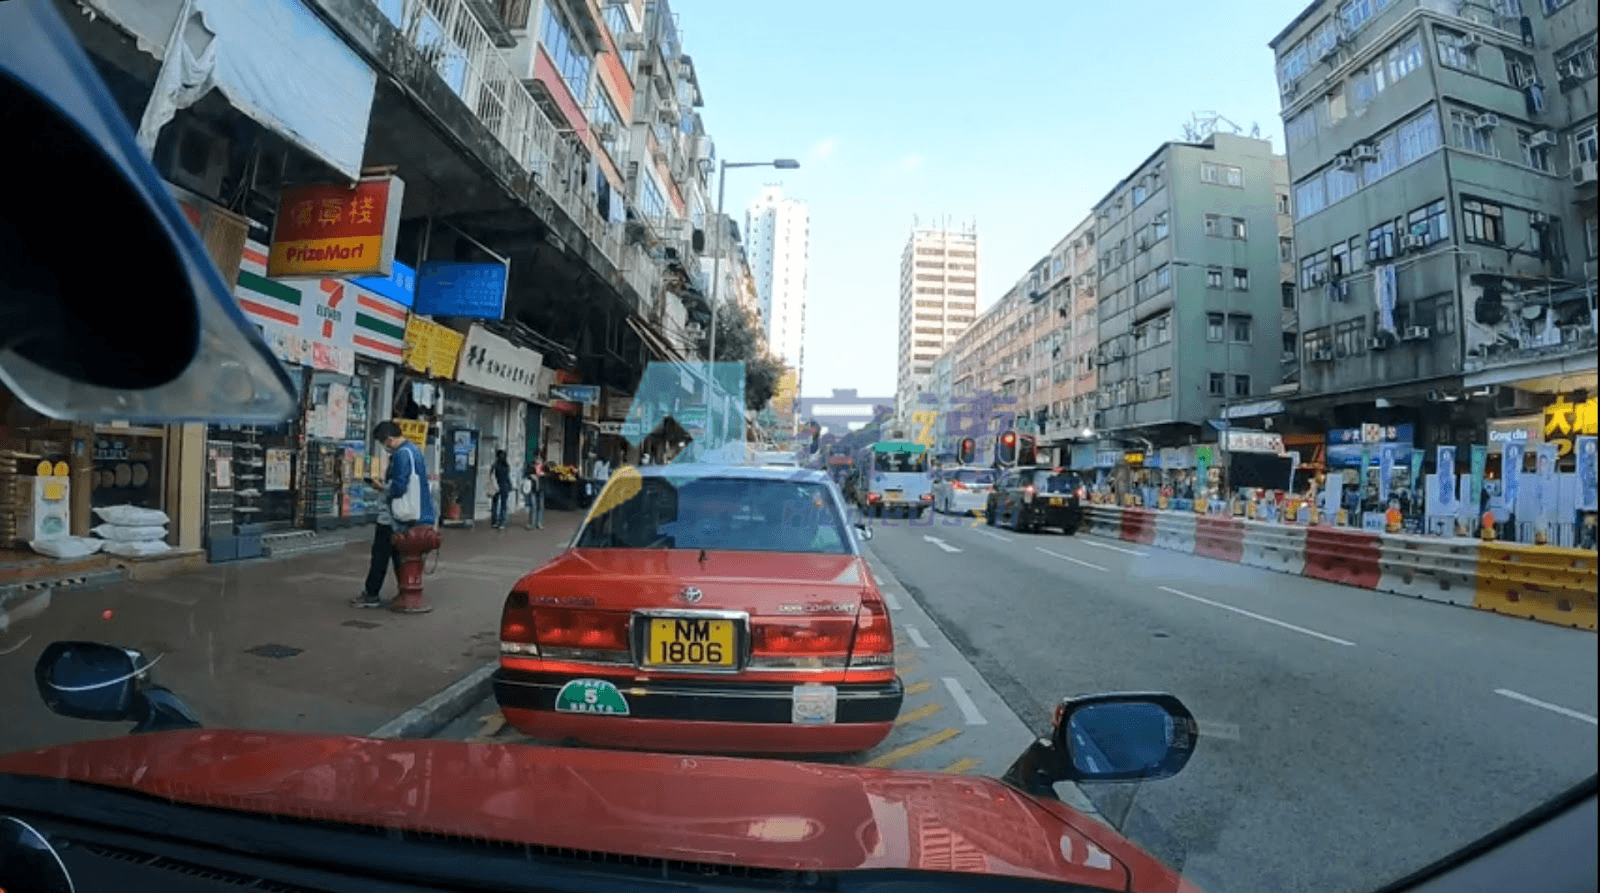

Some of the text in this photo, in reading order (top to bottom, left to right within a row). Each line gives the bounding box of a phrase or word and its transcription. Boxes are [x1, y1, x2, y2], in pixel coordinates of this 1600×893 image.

[286, 243, 364, 262] PrizeMart
[1490, 431, 1512, 442] Gong
[1513, 428, 1527, 440] cha
[675, 619, 709, 641] NM
[661, 642, 722, 663] 1806
[584, 689, 599, 704] 5
